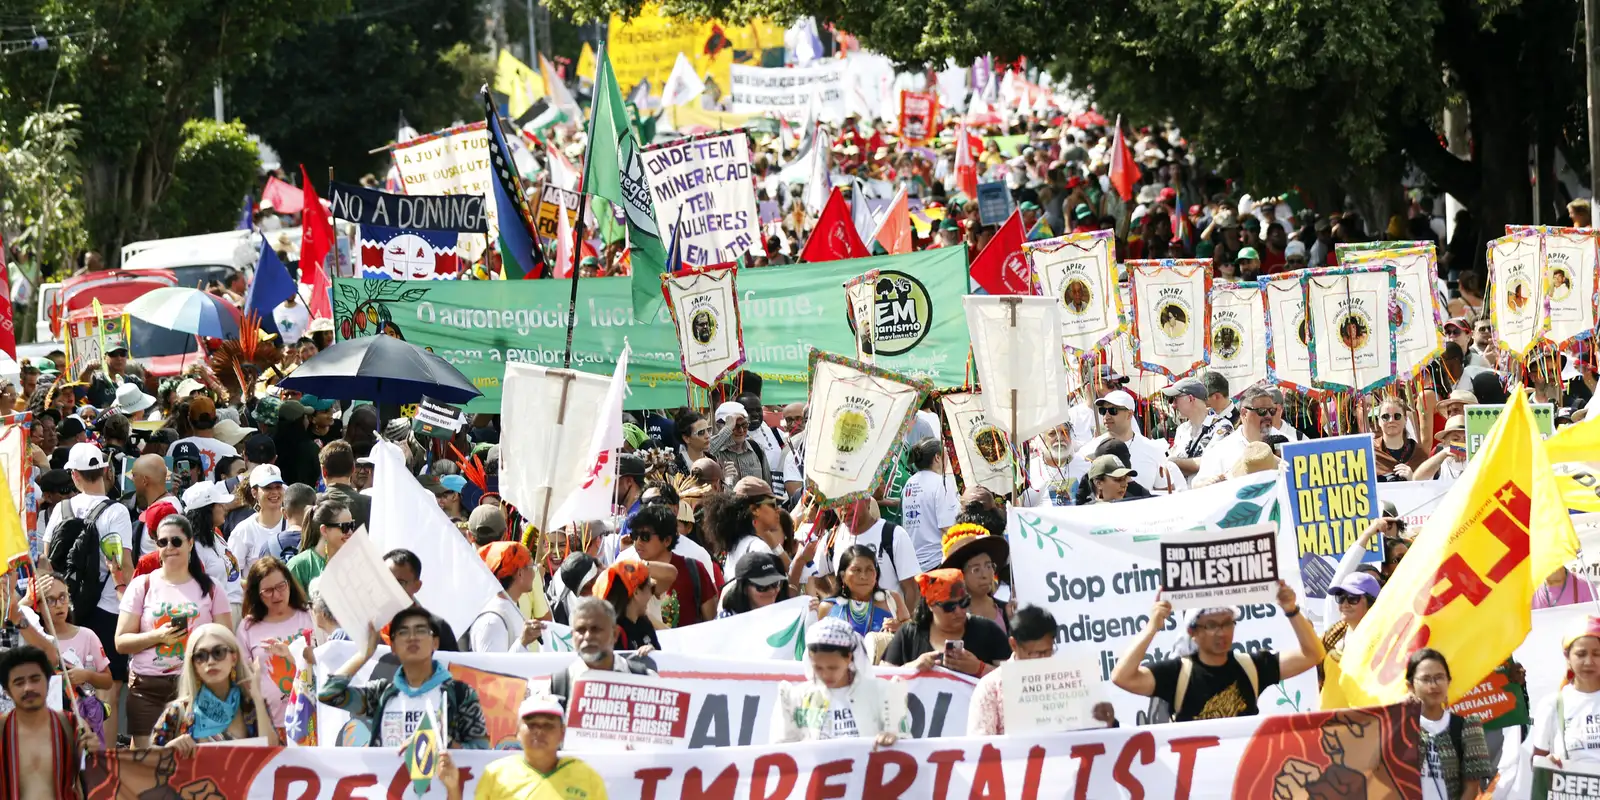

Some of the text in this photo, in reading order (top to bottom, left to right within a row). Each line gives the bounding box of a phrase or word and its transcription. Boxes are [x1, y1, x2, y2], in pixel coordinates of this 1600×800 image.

[647, 139, 735, 176] ONDE TEM
[405, 173, 428, 184] QUE
[654, 160, 749, 204] MINERAÇÃO
[332, 189, 490, 231] NO A DOMINGA
[686, 192, 717, 214] TEM
[686, 244, 709, 265] EM
[1547, 252, 1570, 262] APIRI
[1061, 263, 1086, 275] TAPIRI
[1158, 287, 1183, 297] TAPIRI
[417, 301, 436, 324] O
[439, 303, 580, 336] agronegócio
[742, 290, 824, 318] fome,
[1213, 310, 1238, 321] TAPIRI
[845, 395, 875, 409] TAPIRI
[1293, 448, 1368, 489] PAREM
[1298, 482, 1371, 523] DE NOS
[1166, 537, 1271, 561] END THE GENOCIDE ON
[1166, 552, 1274, 588] PALESTINE
[1045, 571, 1106, 603] Stop
[1171, 592, 1194, 600] PEOPLES
[1224, 587, 1247, 596] CLIMATE
[1248, 584, 1269, 593] JUSTICE
[1021, 669, 1081, 684] FOR PEOPLE
[1022, 680, 1086, 693] AND PLANET,
[584, 681, 679, 707] END IMPERIALIST
[1018, 690, 1090, 704] AGROECOLOGY
[578, 697, 680, 722] PLUNDER, END THE
[1042, 702, 1069, 711] NOW!
[581, 713, 672, 736] CLIMATE CRISIS!
[1552, 772, 1600, 797] DEFE
